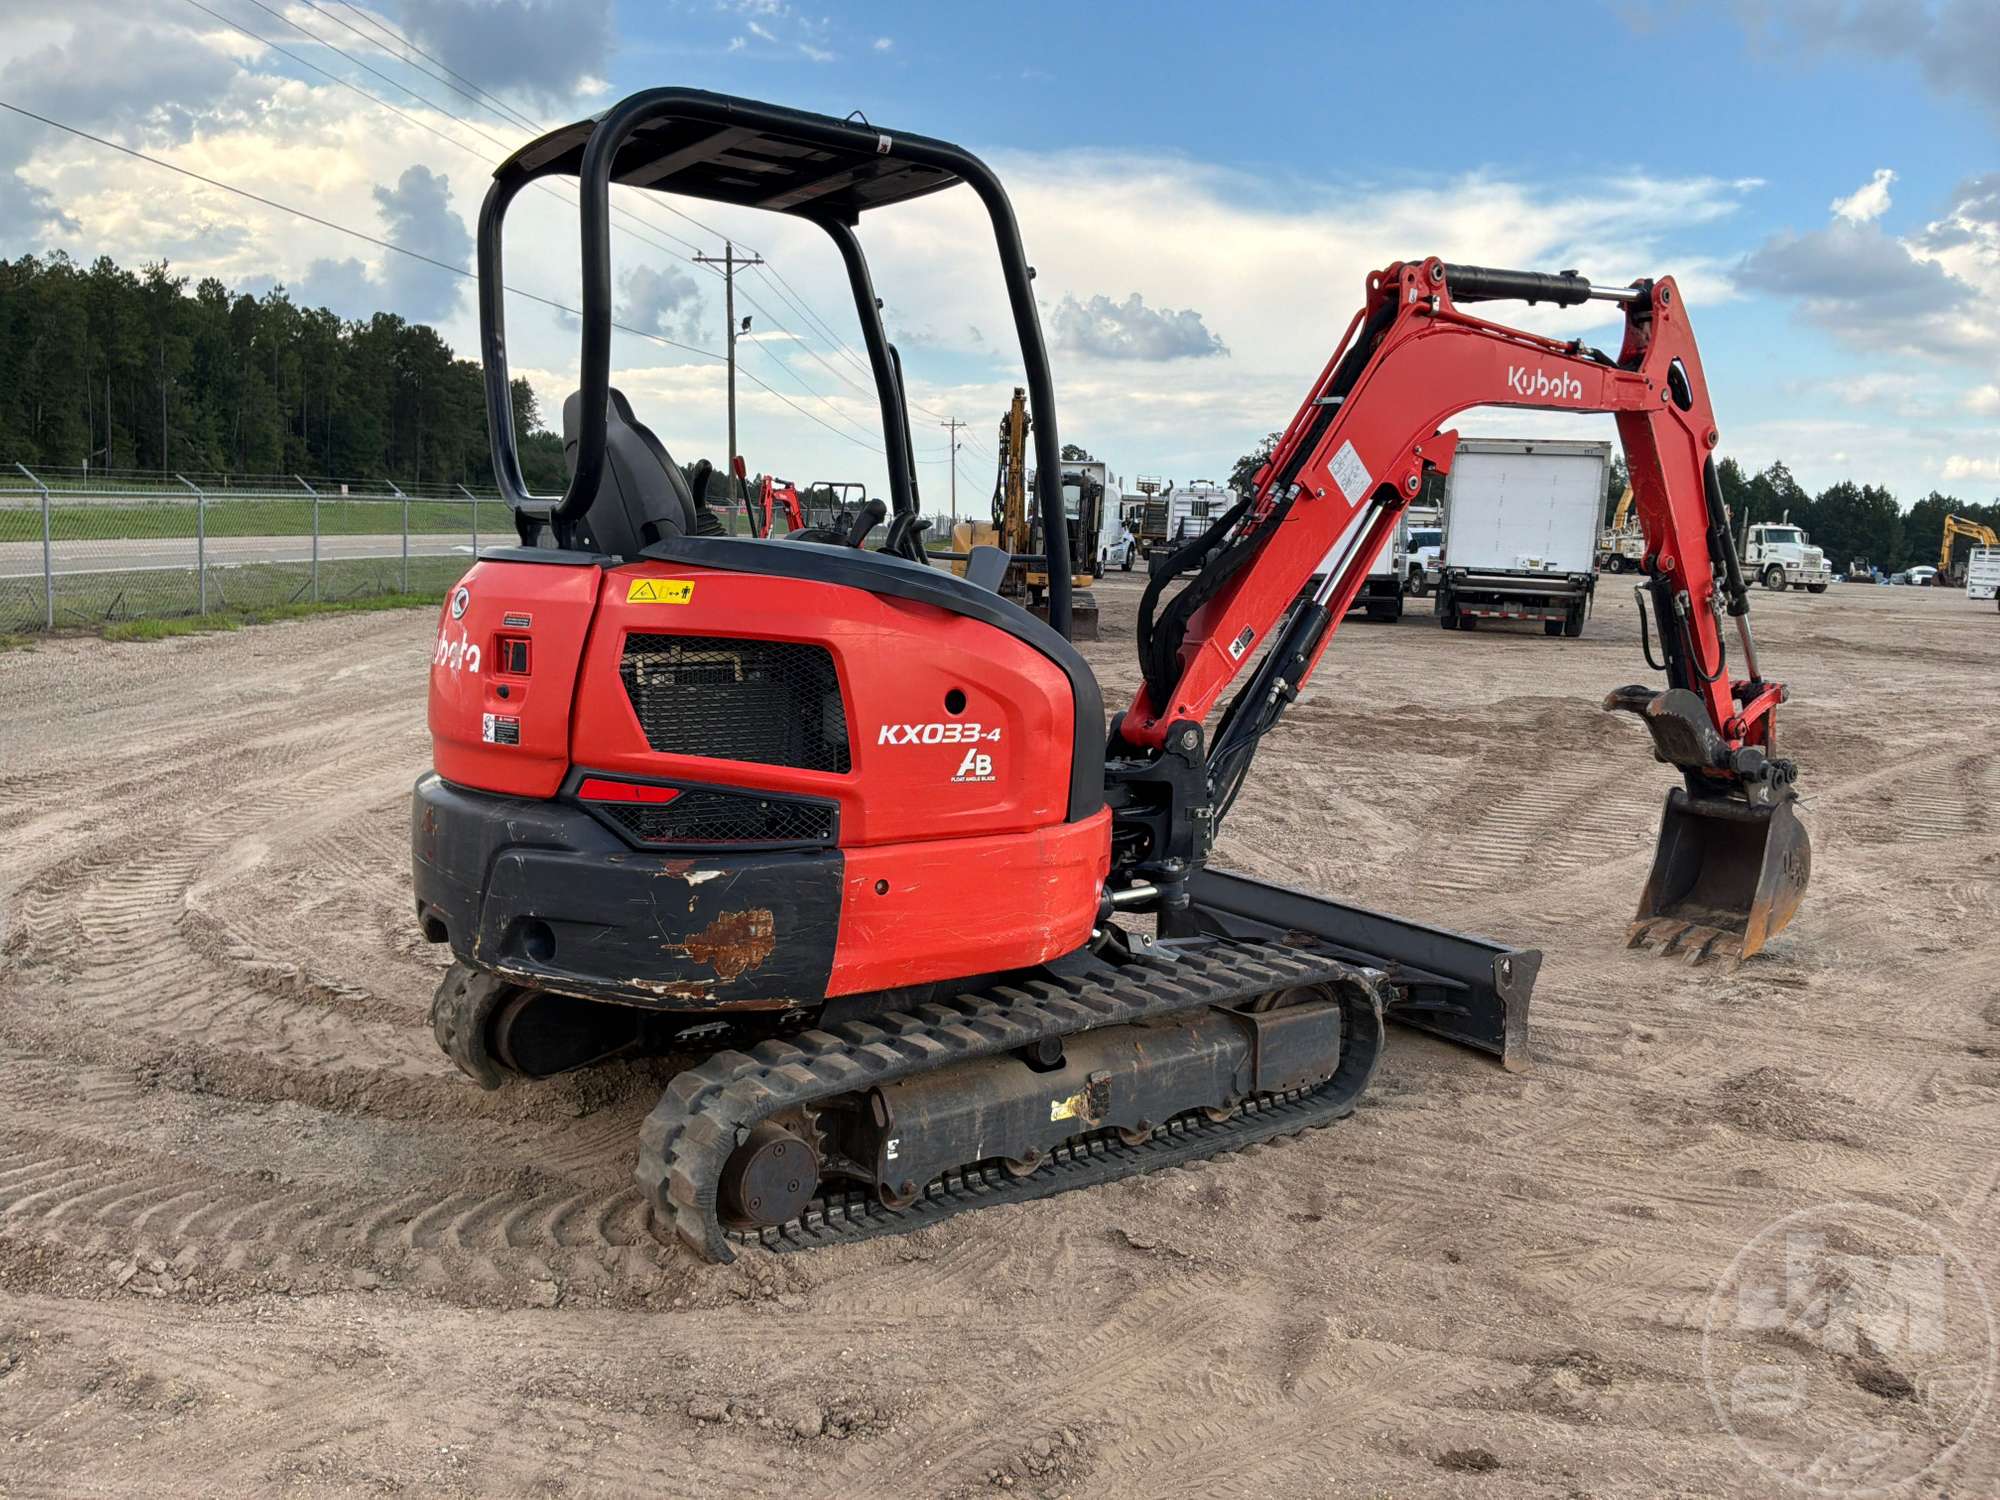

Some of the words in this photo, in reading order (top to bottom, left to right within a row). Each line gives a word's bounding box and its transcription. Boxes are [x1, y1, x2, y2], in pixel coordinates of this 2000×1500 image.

[1508, 366, 1582, 400] Kubota
[433, 628, 481, 673] ubota
[878, 723, 1001, 745] KX033-4
